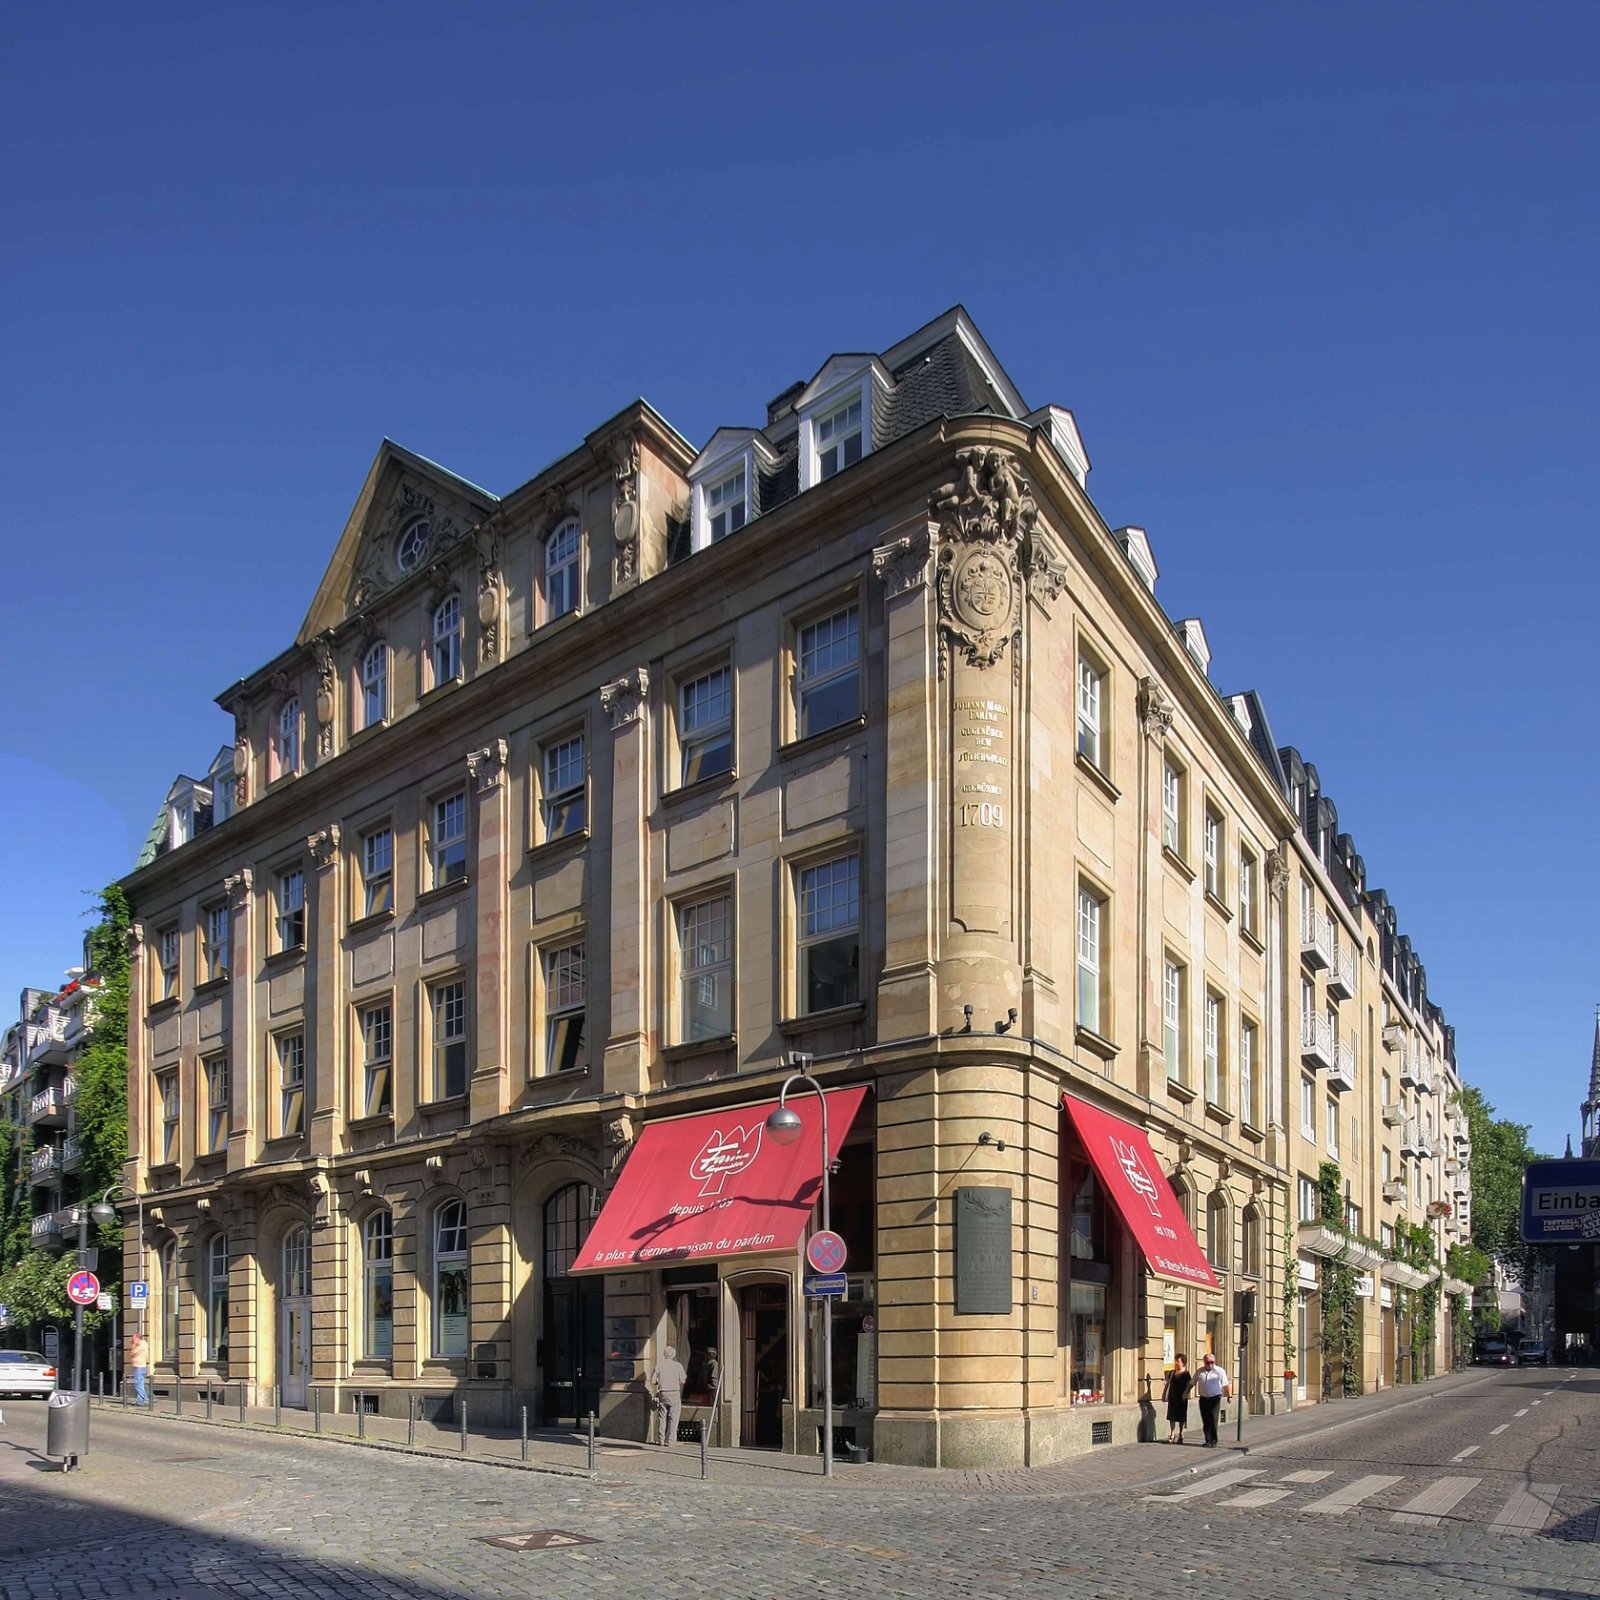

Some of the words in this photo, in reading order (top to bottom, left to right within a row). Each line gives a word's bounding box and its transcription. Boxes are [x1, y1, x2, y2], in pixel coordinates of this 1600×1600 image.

[969, 710, 998, 722] FARINA
[961, 725, 1004, 739] GEGENÜBER
[959, 802, 1004, 828] 1709
[668, 1202, 705, 1216] depuis
[594, 1251, 603, 1261] la
[604, 1249, 626, 1263] plus
[628, 1246, 673, 1259] ancienne
[715, 1237, 732, 1249] du
[732, 1233, 775, 1249] parfum
[134, 1284, 144, 1297] P
